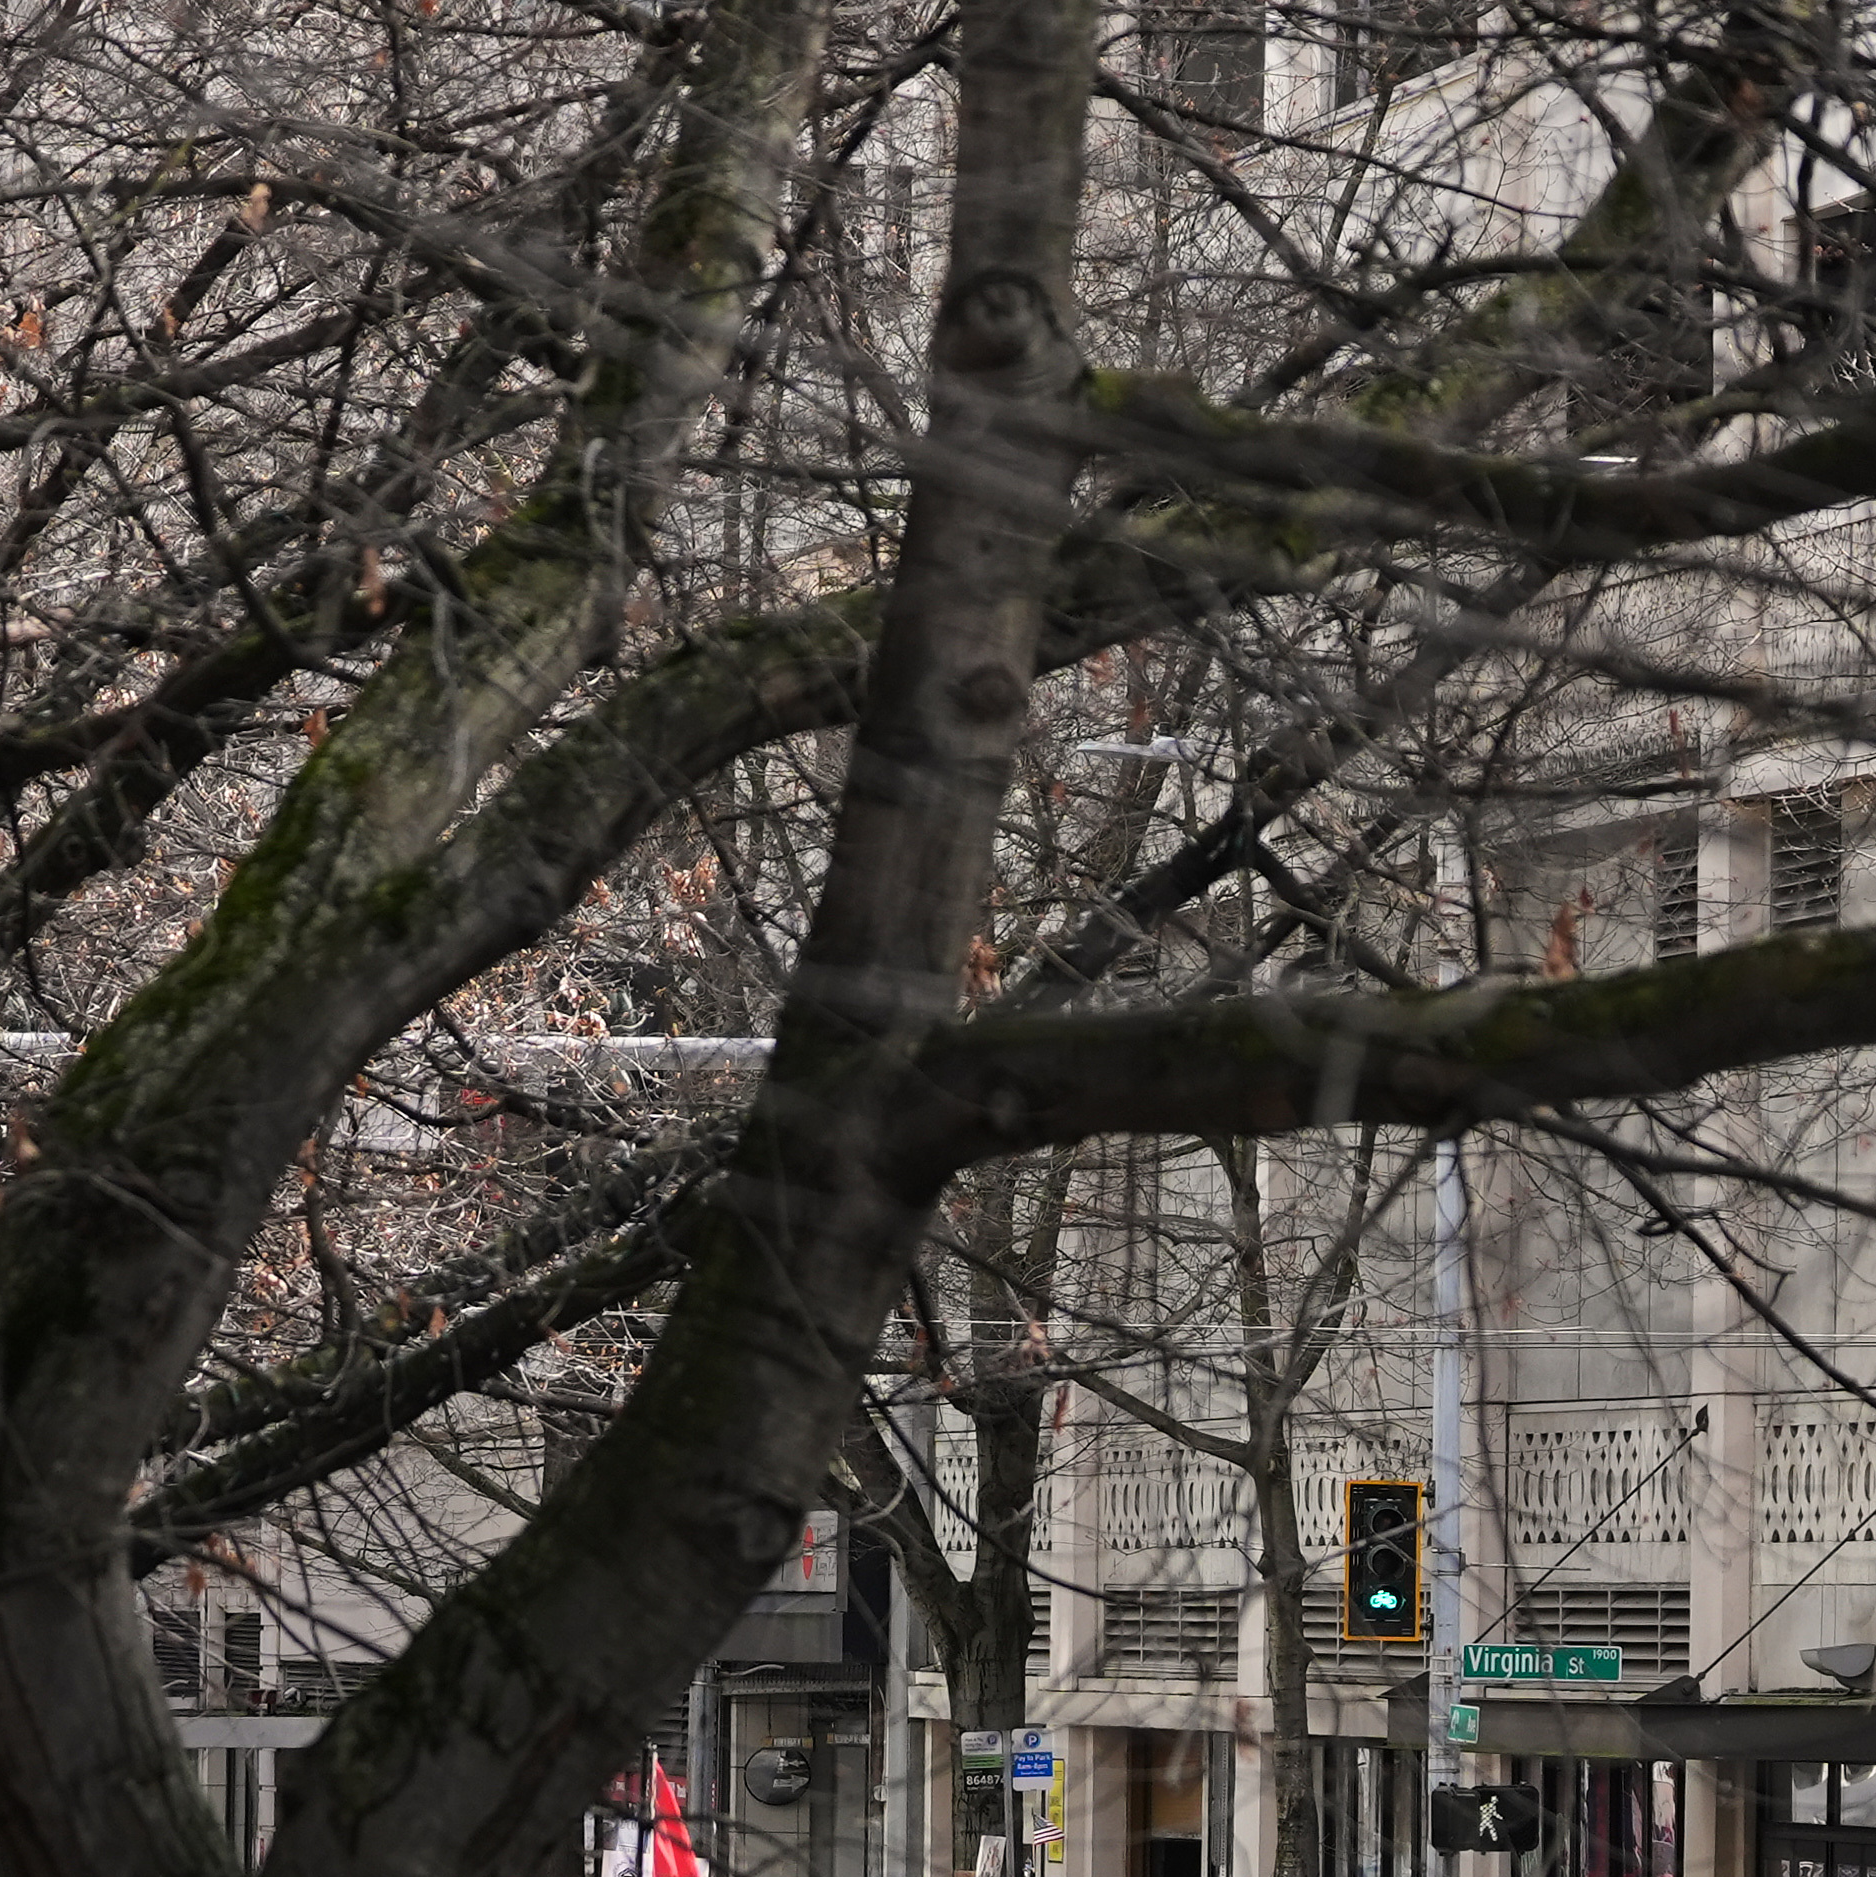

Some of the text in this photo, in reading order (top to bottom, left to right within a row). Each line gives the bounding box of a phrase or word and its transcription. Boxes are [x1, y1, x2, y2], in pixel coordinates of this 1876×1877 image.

[1469, 1646, 1617, 1677] Virginia St 1900
